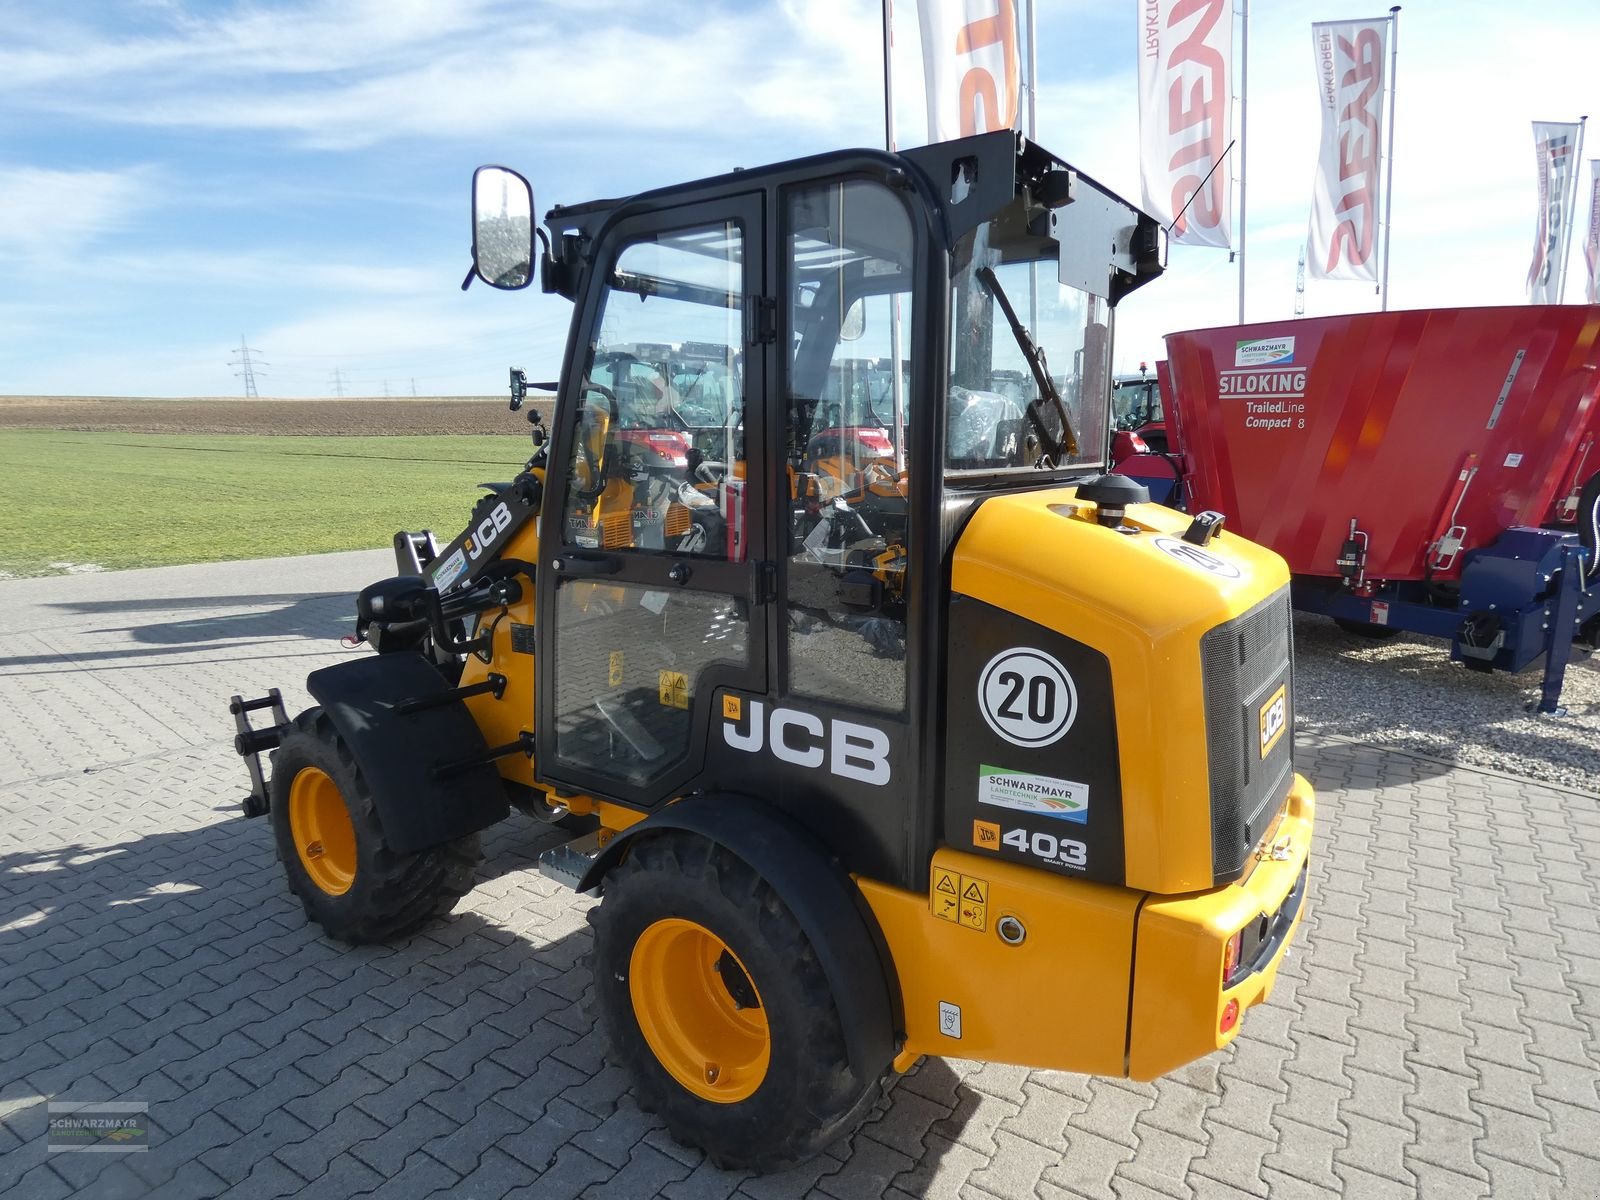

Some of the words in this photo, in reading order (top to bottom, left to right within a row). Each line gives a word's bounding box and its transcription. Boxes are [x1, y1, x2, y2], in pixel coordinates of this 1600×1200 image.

[1241, 343, 1286, 353] SCHWARZMAYR
[1219, 373, 1306, 393] SILOKING
[1246, 401, 1305, 413] TrailedLine
[1497, 397, 1504, 405] 2
[1246, 416, 1292, 430] Compact
[1297, 418, 1305, 429] 8
[469, 502, 512, 560] JCB
[997, 671, 1056, 724] 20
[1263, 697, 1284, 745] JCB
[723, 700, 891, 786] JCB
[989, 775, 1072, 799] SCHWARZMAYR
[990, 786, 1038, 801] LANDTECHNIK
[1002, 828, 1087, 866] 403
